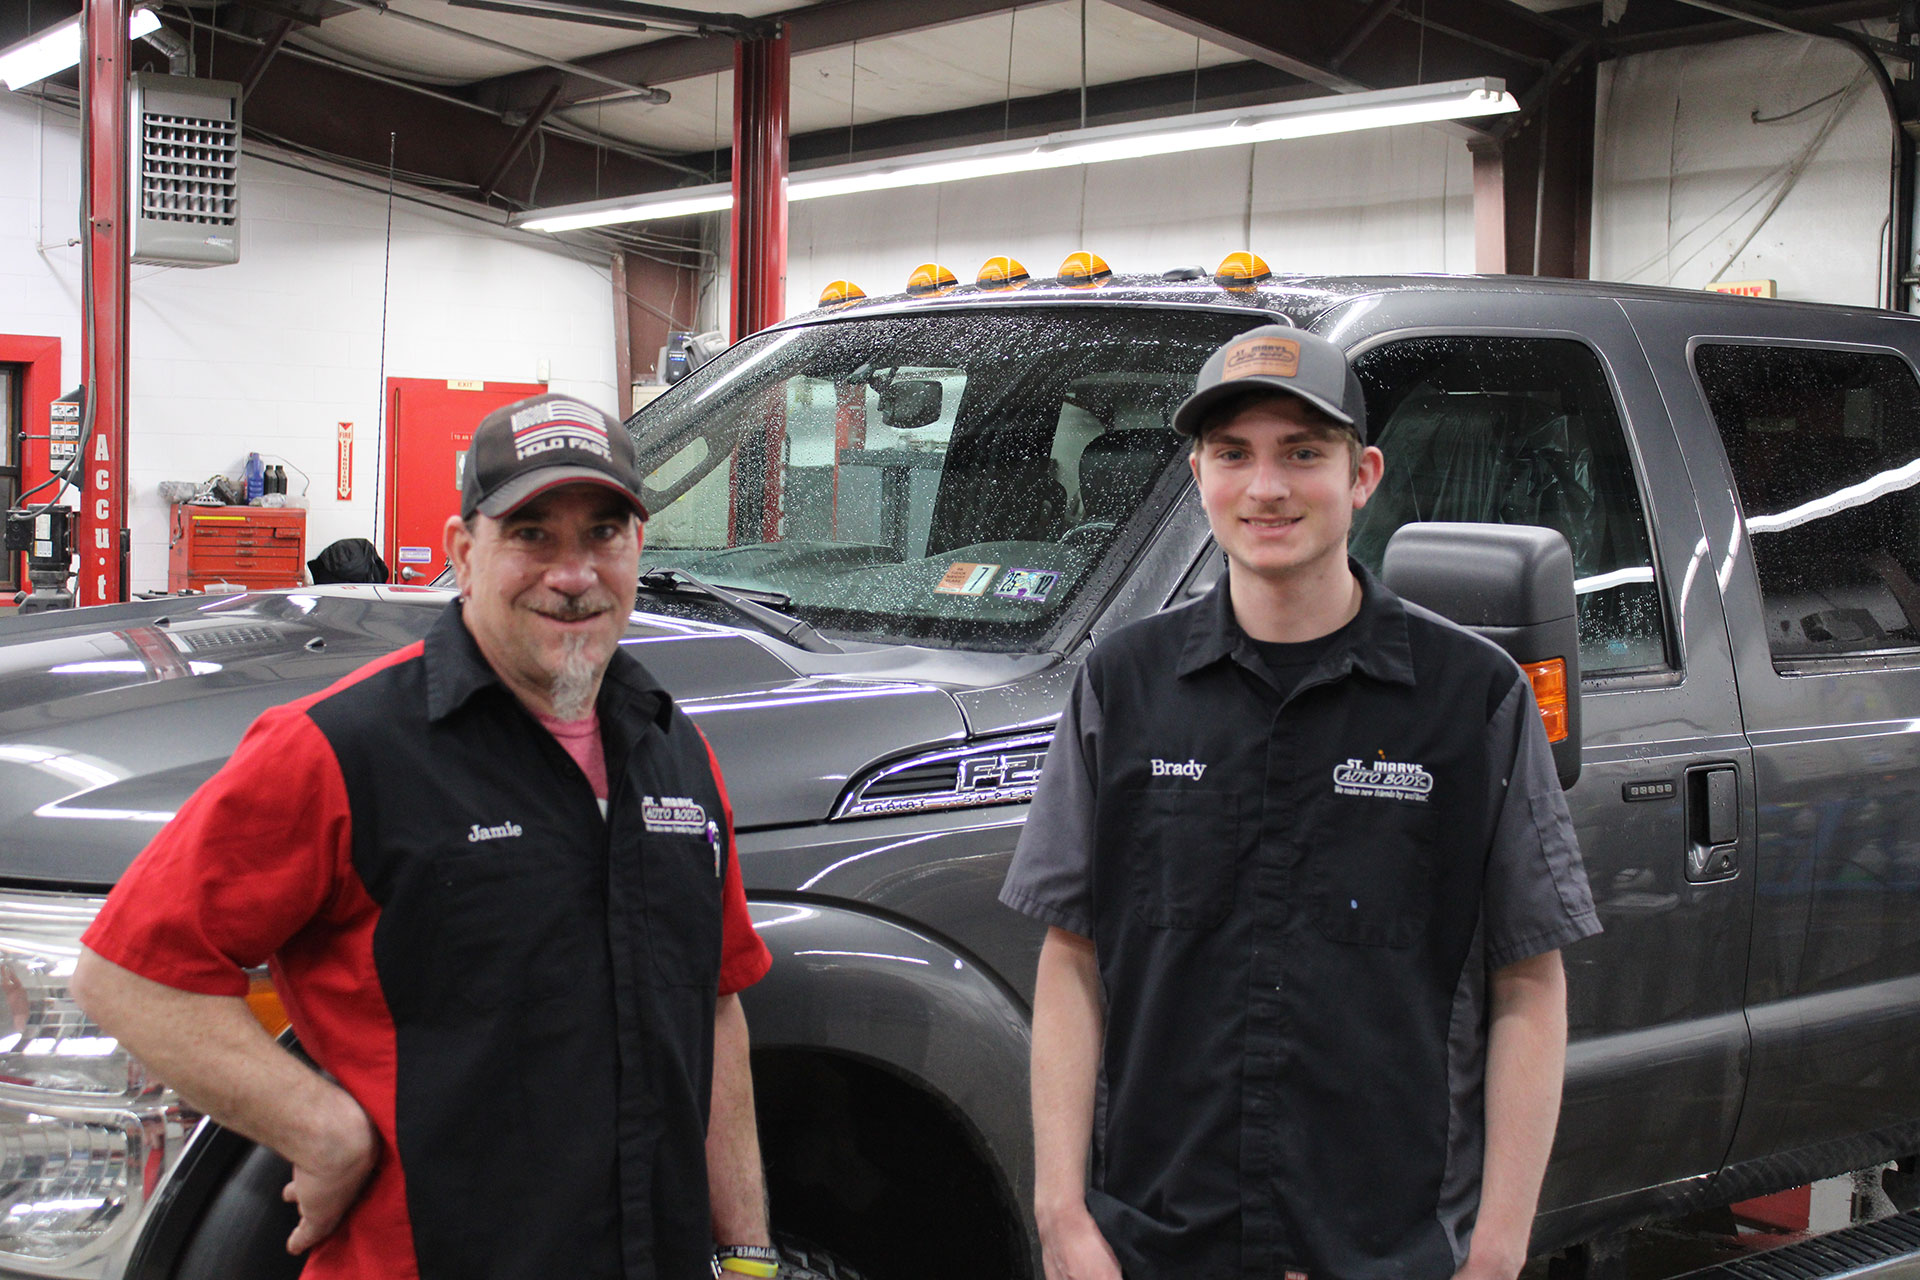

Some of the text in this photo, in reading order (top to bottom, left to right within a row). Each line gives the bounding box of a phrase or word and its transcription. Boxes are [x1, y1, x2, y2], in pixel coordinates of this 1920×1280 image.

[339, 431, 351, 440] FIRE
[516, 437, 565, 461] HOLD
[968, 567, 989, 592] 7
[1000, 572, 1021, 592] 25
[1034, 575, 1055, 595] 12
[1150, 758, 1207, 781] Brady
[1347, 758, 1423, 774] ST. MARYS
[1340, 769, 1381, 783] AUTO
[1382, 773, 1423, 787] BODY
[863, 789, 1033, 814] LARIAT SUPER
[646, 807, 672, 820] AUTO
[468, 820, 523, 842] Jamie
